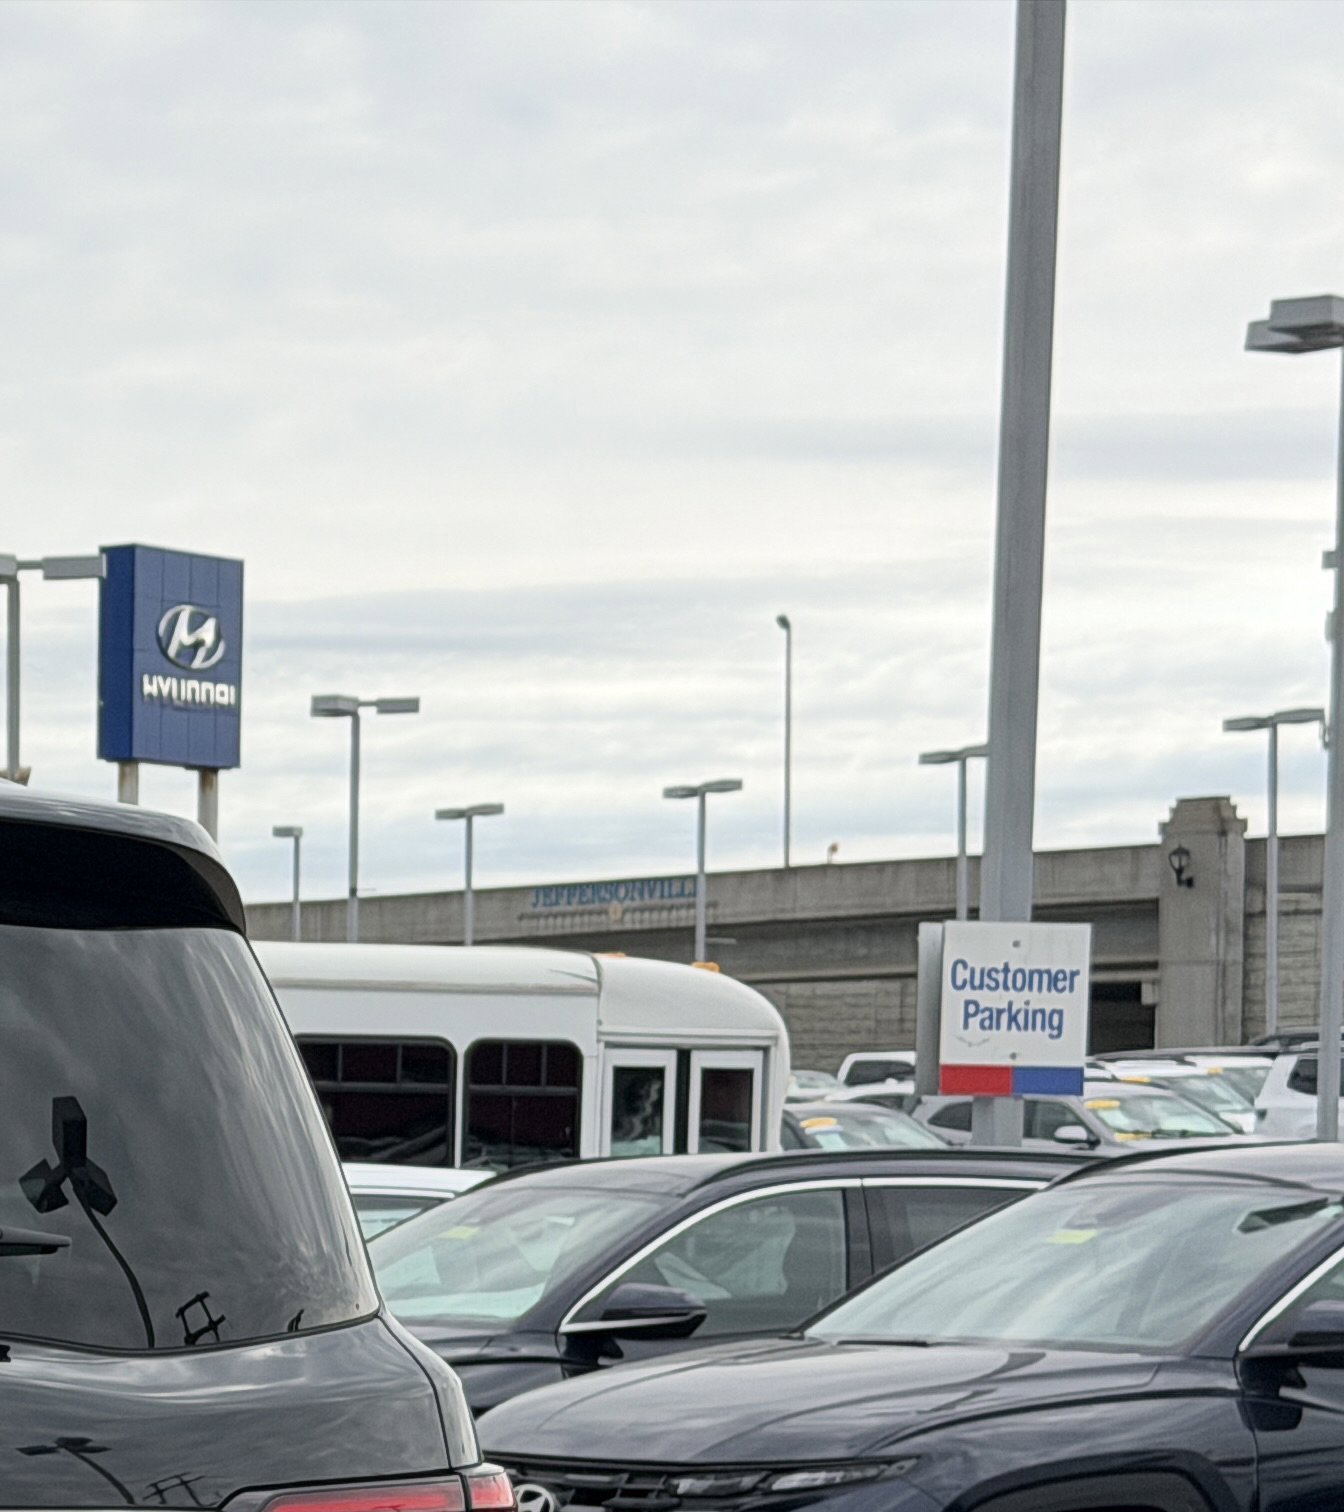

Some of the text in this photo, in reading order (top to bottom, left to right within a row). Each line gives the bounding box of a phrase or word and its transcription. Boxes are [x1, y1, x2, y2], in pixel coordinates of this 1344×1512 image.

[142, 673, 236, 706] HYUNDAI
[531, 878, 700, 909] JEFFERSONVILL
[950, 958, 1080, 994] Customer
[962, 998, 1064, 1040] Parking
